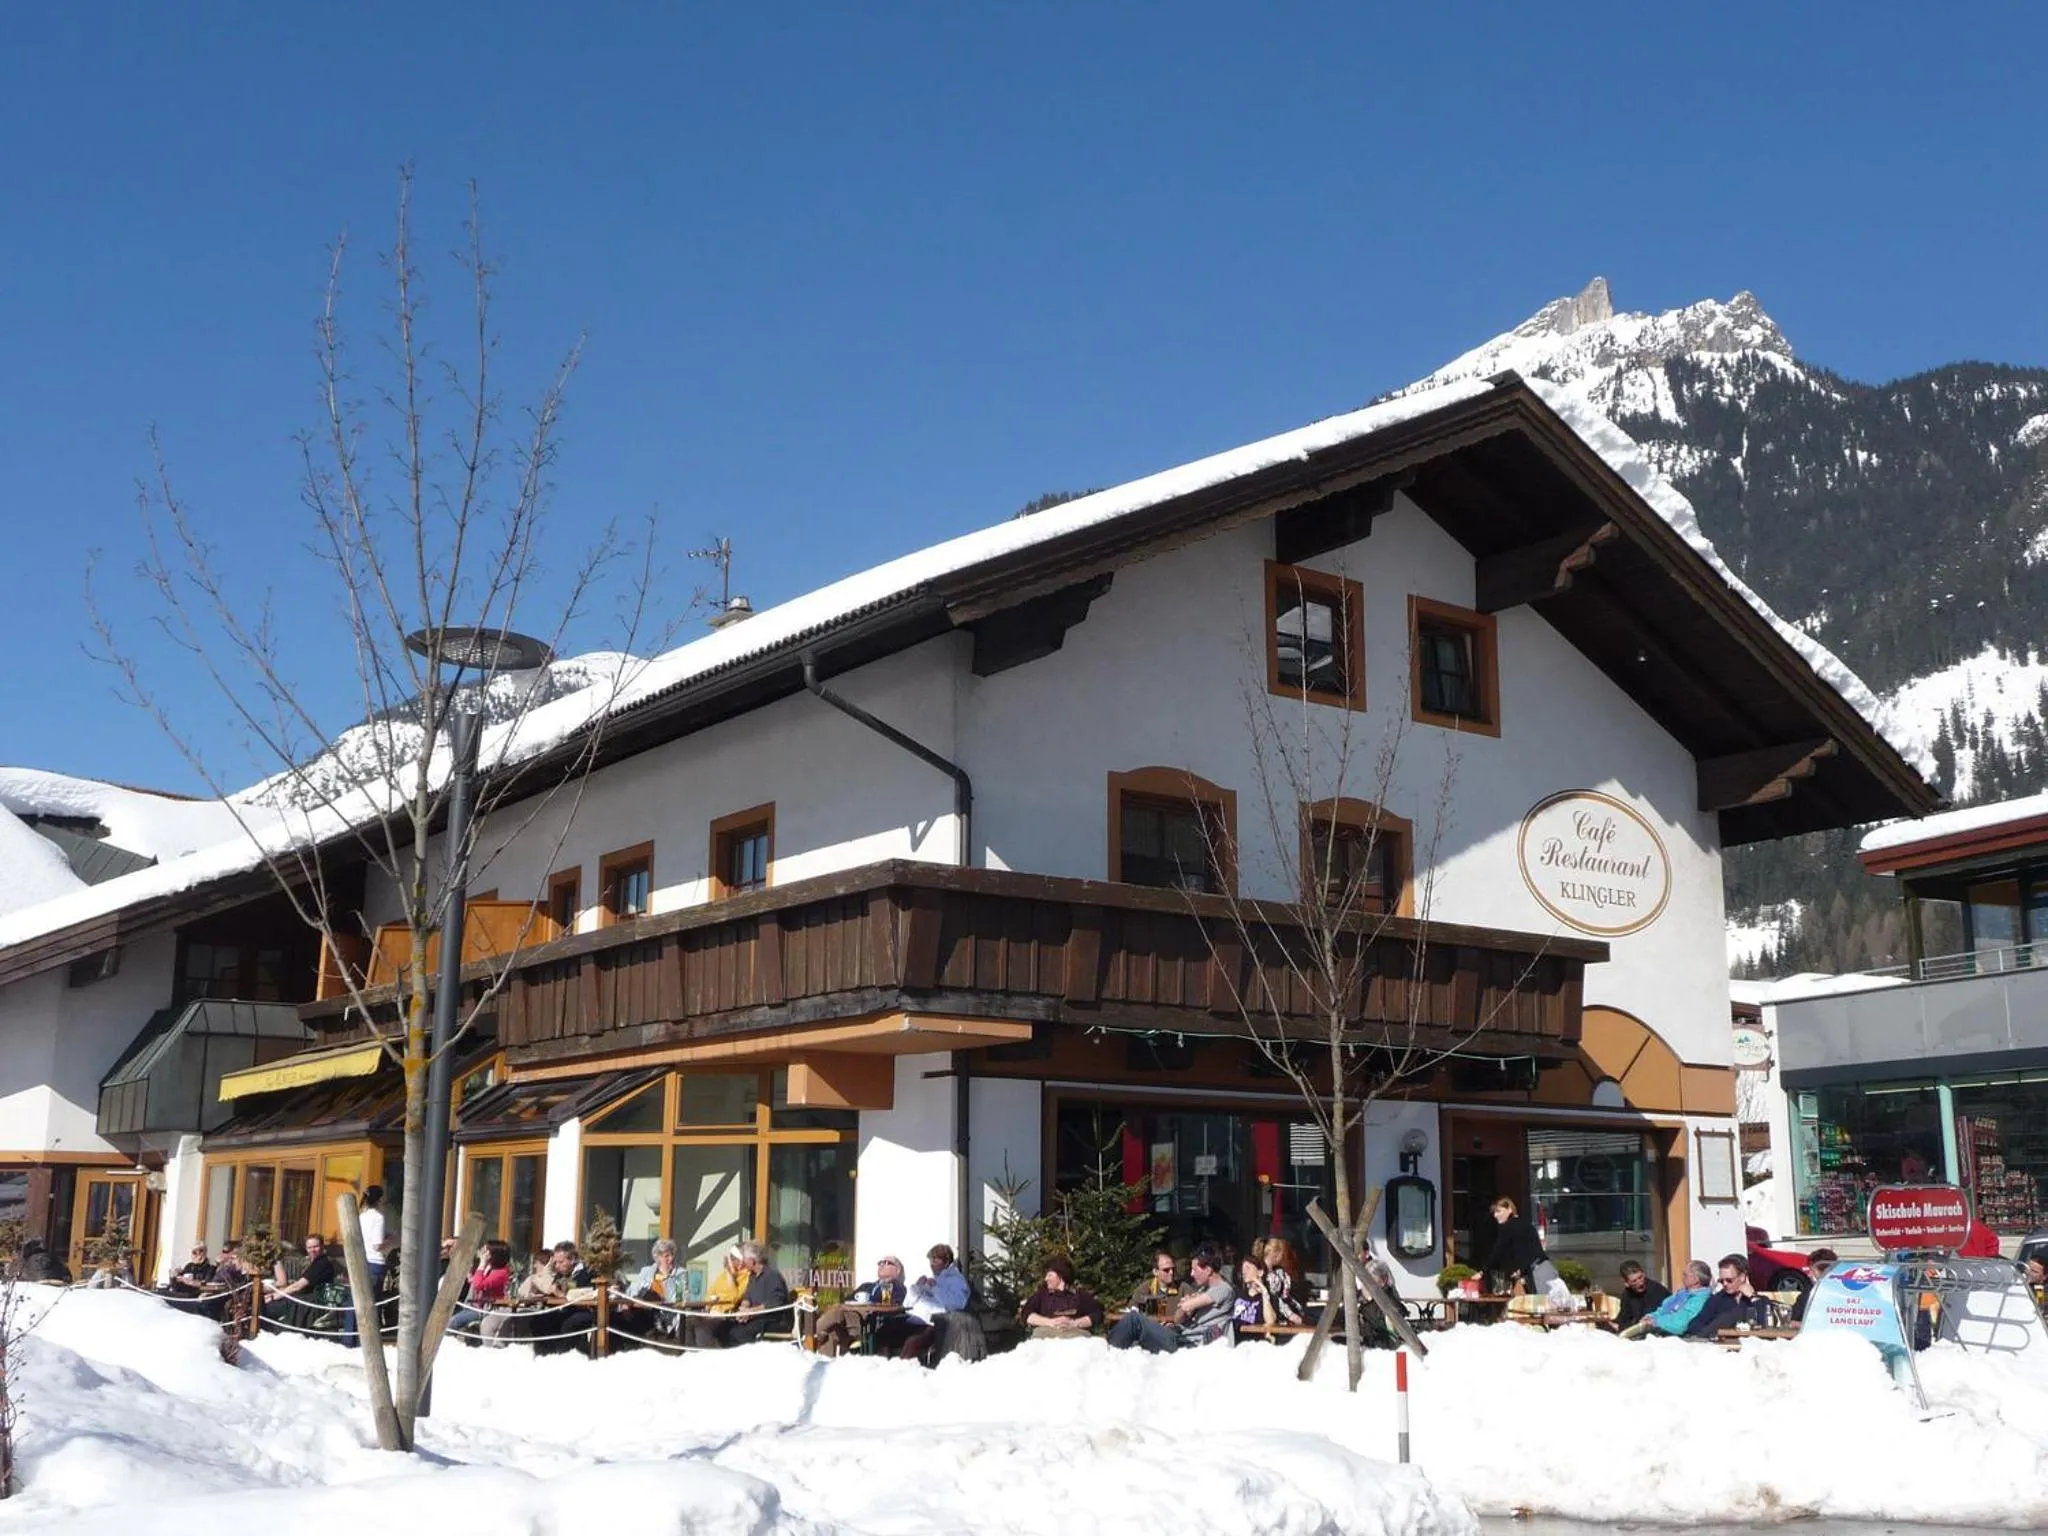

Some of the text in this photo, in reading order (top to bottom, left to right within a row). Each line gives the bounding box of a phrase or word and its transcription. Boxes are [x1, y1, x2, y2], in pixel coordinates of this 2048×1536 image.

[1572, 810, 1617, 853] Café
[1539, 836, 1652, 880] Restaurant
[1560, 881, 1637, 909] KLINGLER
[1876, 1200, 1963, 1219] Skischule Maurach
[1826, 1306, 1882, 1316] SNOWBOARD
[1830, 1317, 1874, 1326] LANGLAUF
